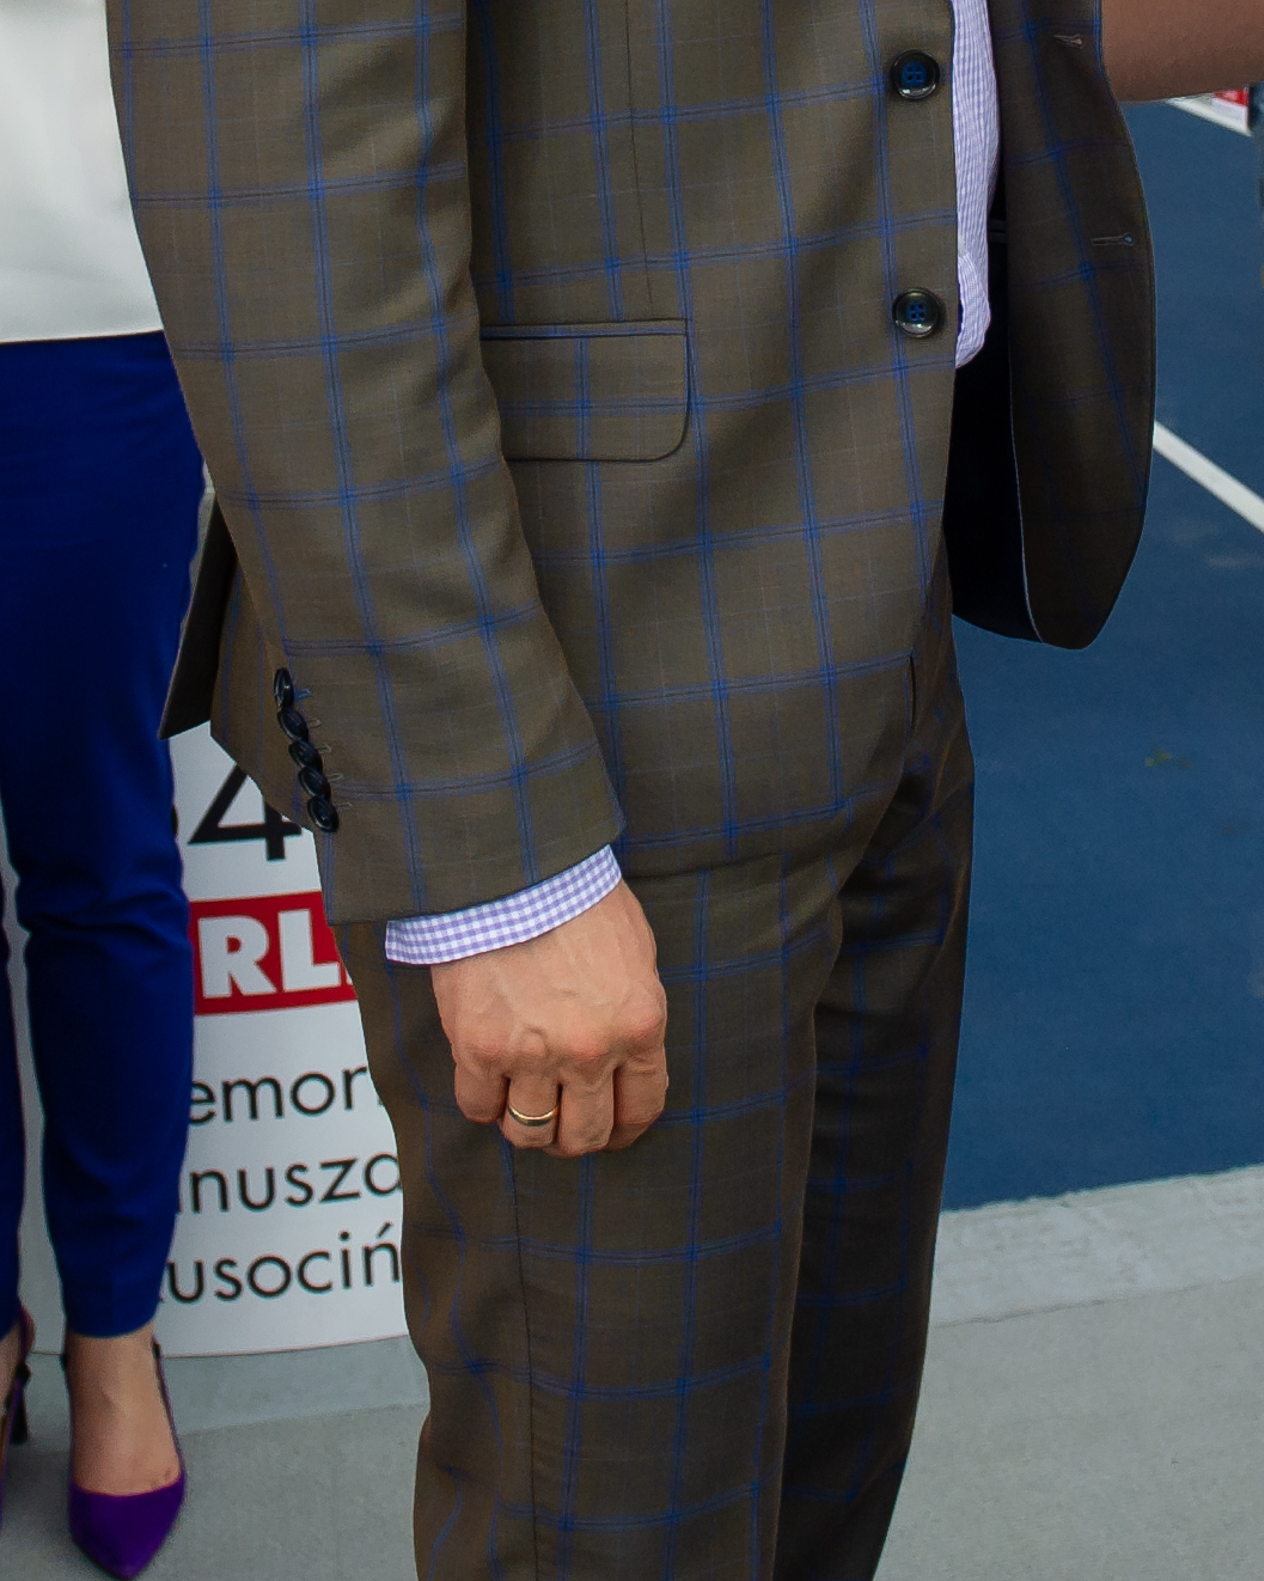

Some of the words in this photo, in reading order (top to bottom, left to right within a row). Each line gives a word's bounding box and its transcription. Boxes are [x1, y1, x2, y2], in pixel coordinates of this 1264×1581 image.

[172, 764, 302, 861] 4
[197, 908, 353, 1000] RL
[189, 1066, 383, 1126] emor
[176, 1152, 402, 1215] nusza
[159, 1222, 400, 1305] usociń
